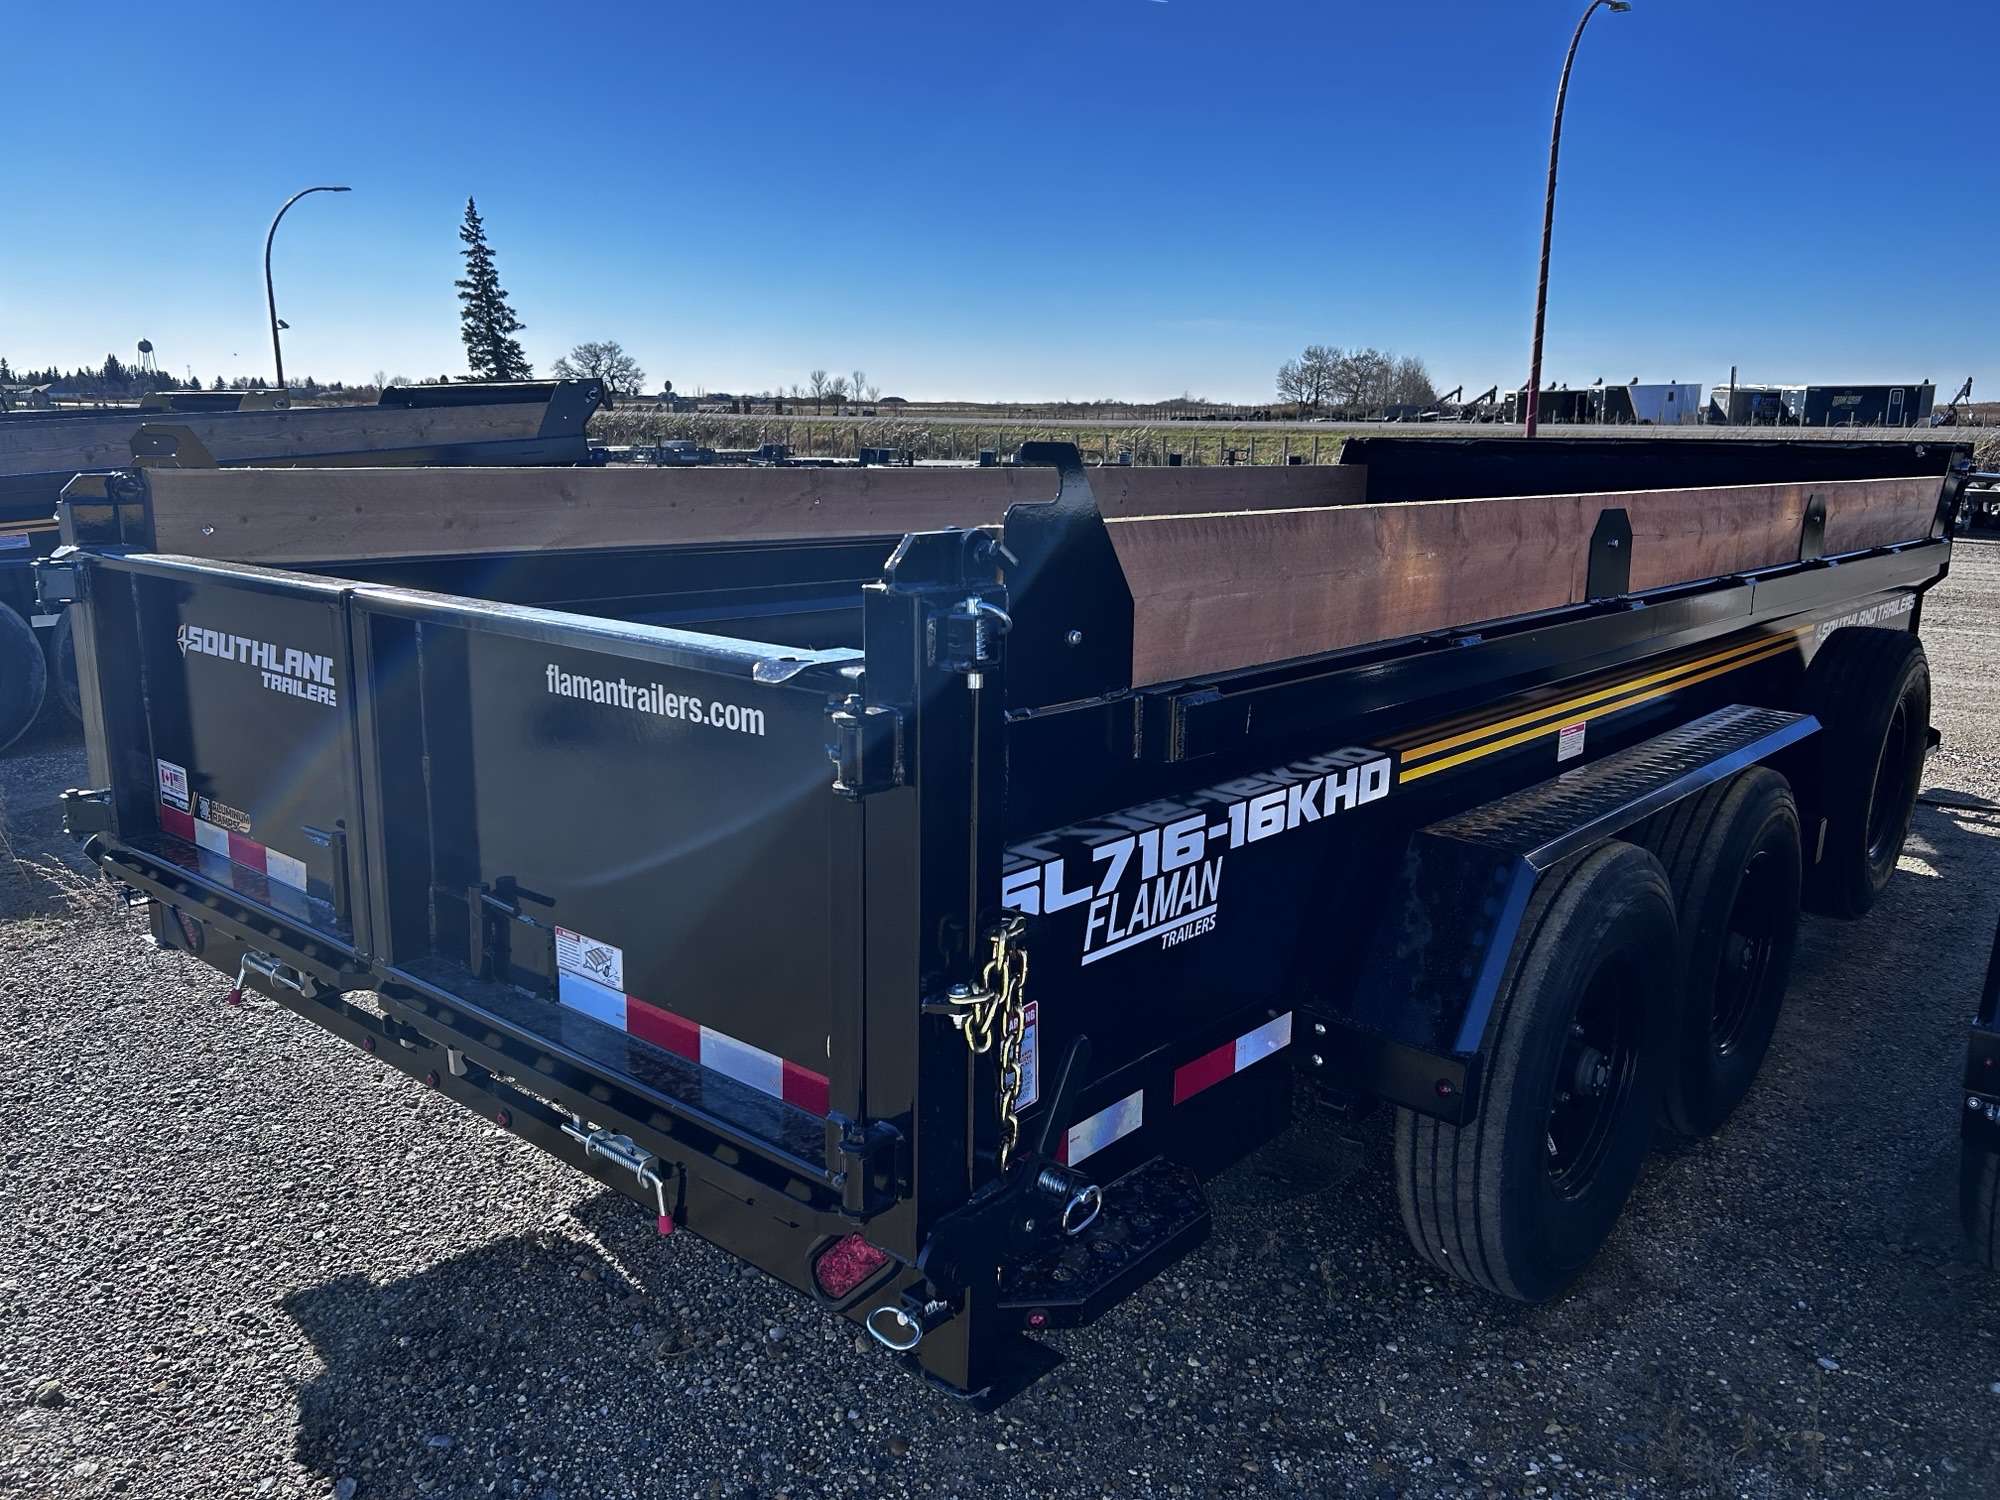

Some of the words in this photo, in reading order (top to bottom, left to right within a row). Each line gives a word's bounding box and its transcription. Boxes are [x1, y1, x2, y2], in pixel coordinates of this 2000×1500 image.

[545, 663, 765, 736] flamantrailers.com
[1001, 757, 1392, 916] SL716-16KHD
[1083, 855, 1223, 952] FLAMAN
[1161, 914, 1217, 950] TRAILERS
